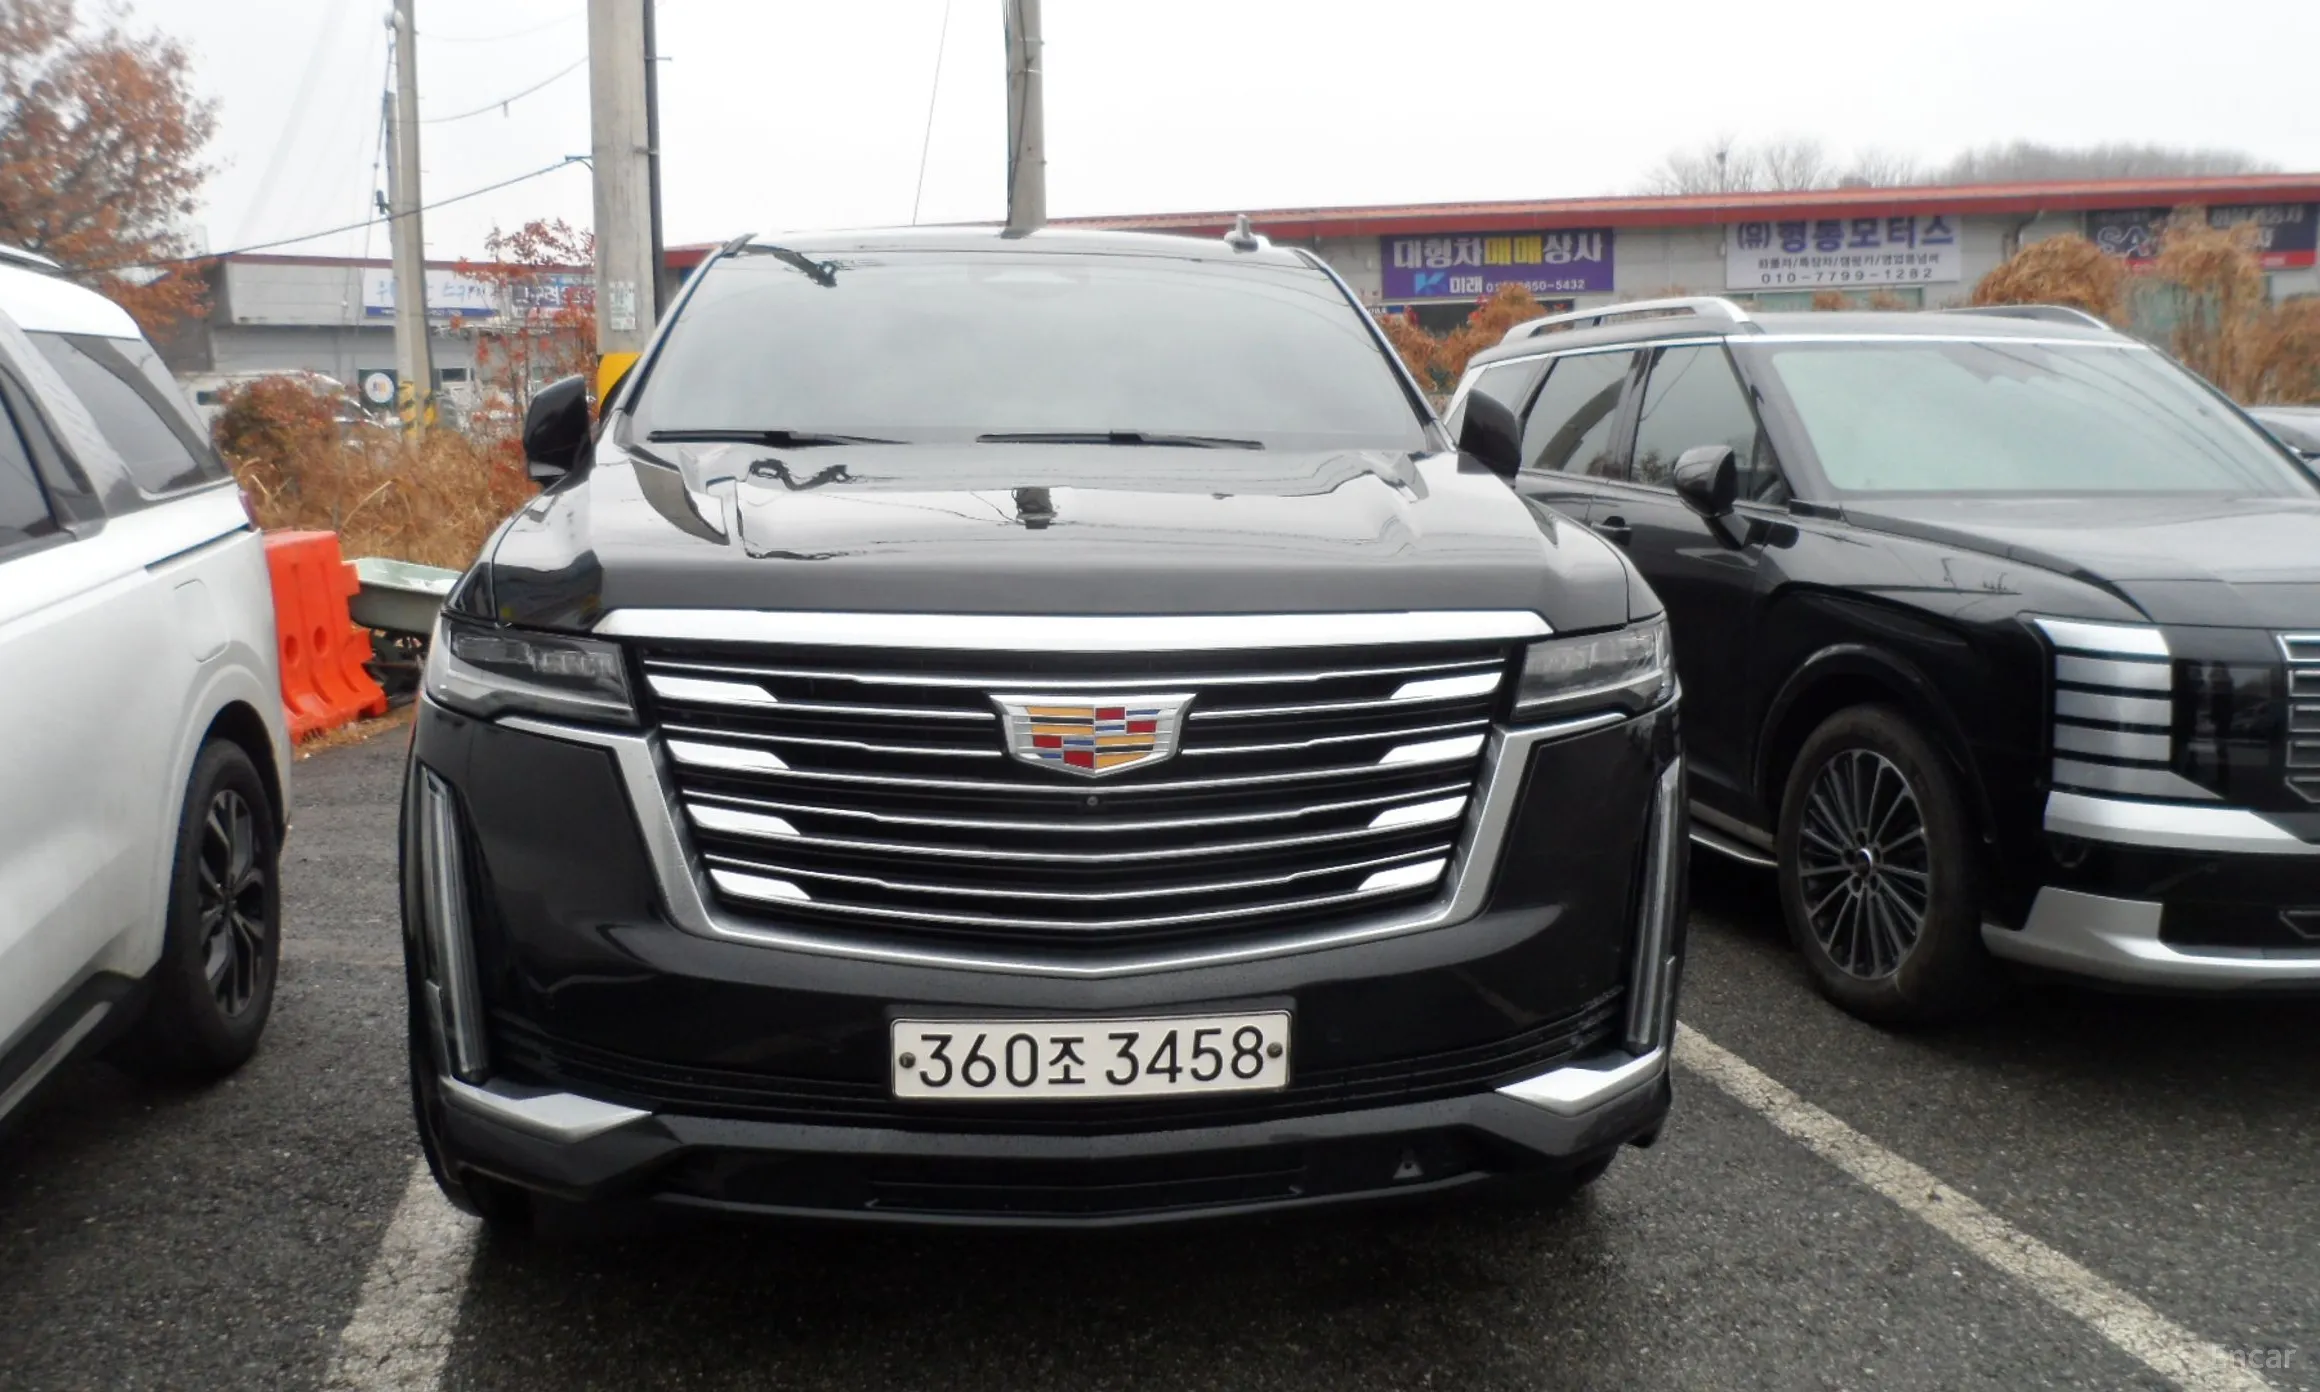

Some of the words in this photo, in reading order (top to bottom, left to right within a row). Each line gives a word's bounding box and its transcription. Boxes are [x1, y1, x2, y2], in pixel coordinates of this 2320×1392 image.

[1393, 233, 1602, 268] 대형차매매상사
[1449, 275, 1483, 294] 미래
[1760, 267, 1934, 285] 010-7799-1282
[919, 1032, 1086, 1088] 360조
[1105, 1024, 1265, 1086] 3458
